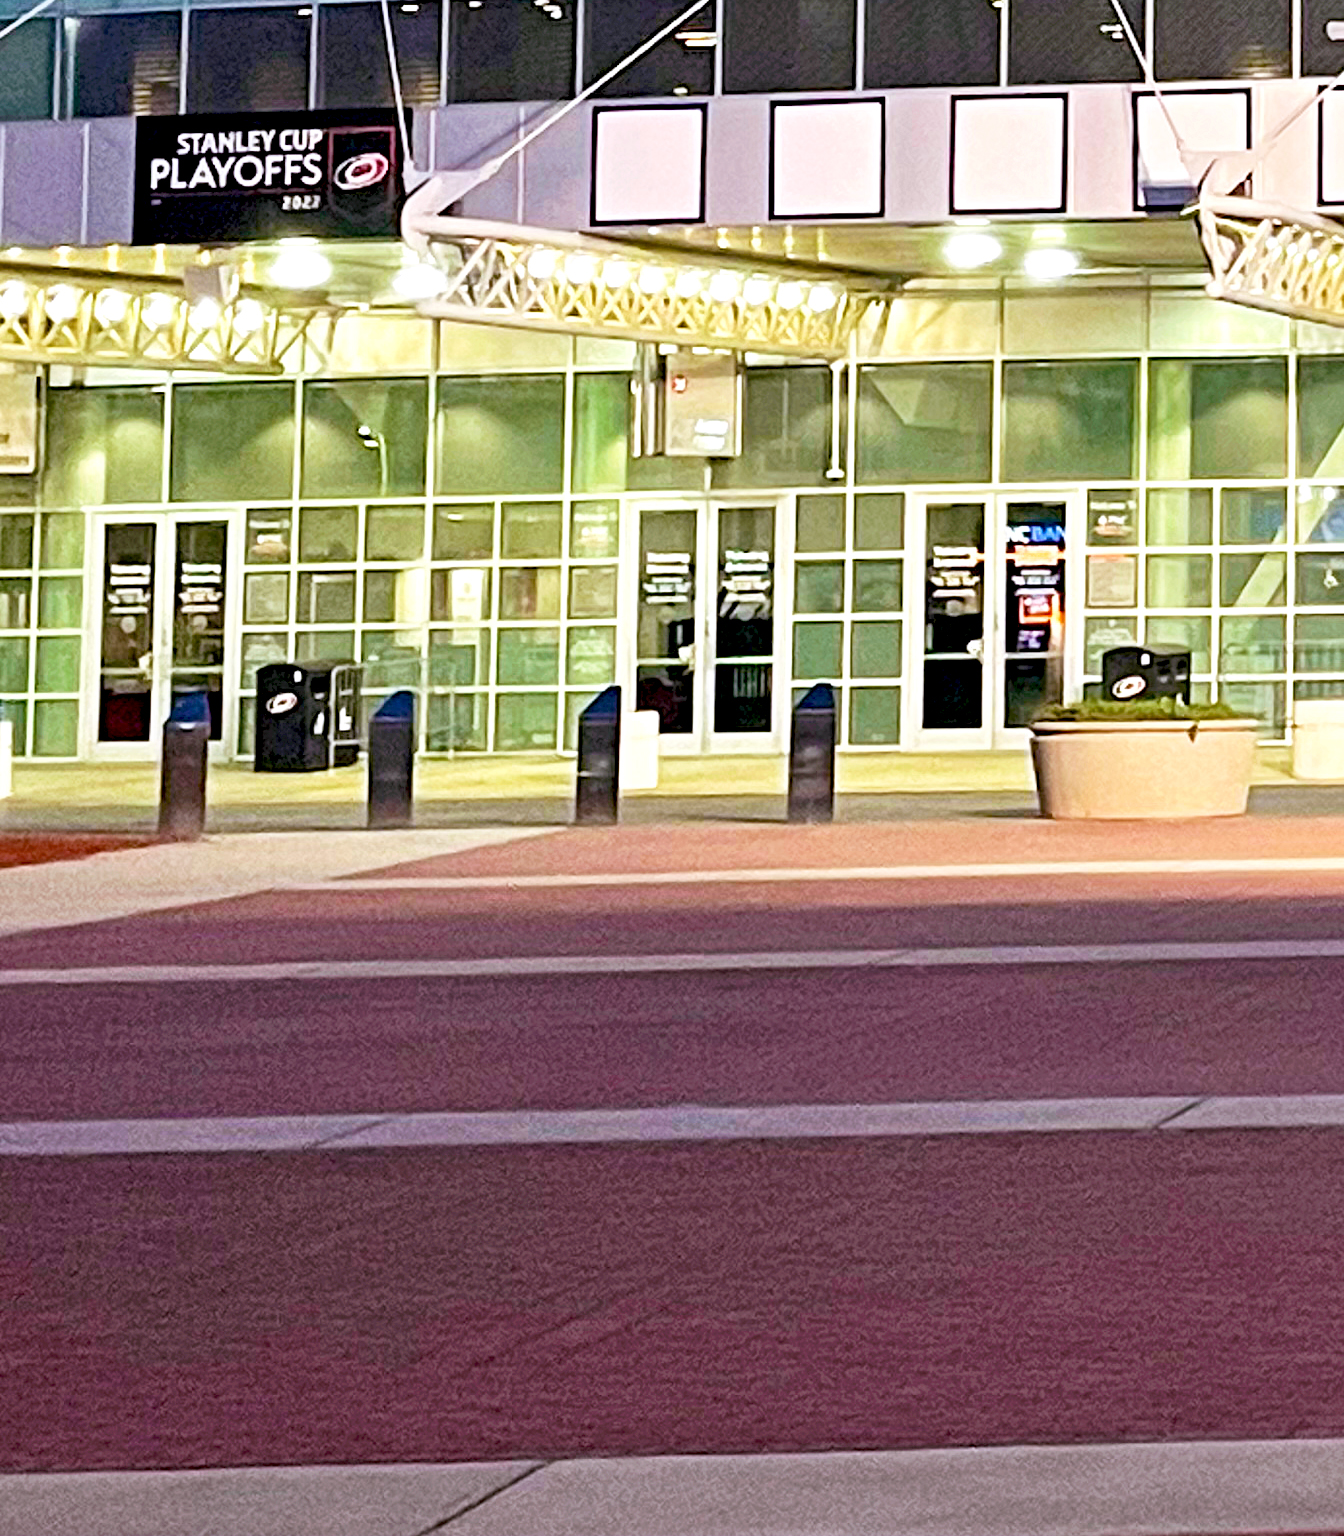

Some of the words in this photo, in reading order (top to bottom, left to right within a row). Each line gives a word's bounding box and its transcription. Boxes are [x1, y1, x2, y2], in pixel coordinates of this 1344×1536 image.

[176, 128, 276, 155] STANLEY
[278, 128, 323, 152] CUP
[150, 152, 323, 190] PLAYOFFS
[281, 194, 322, 211] 2022
